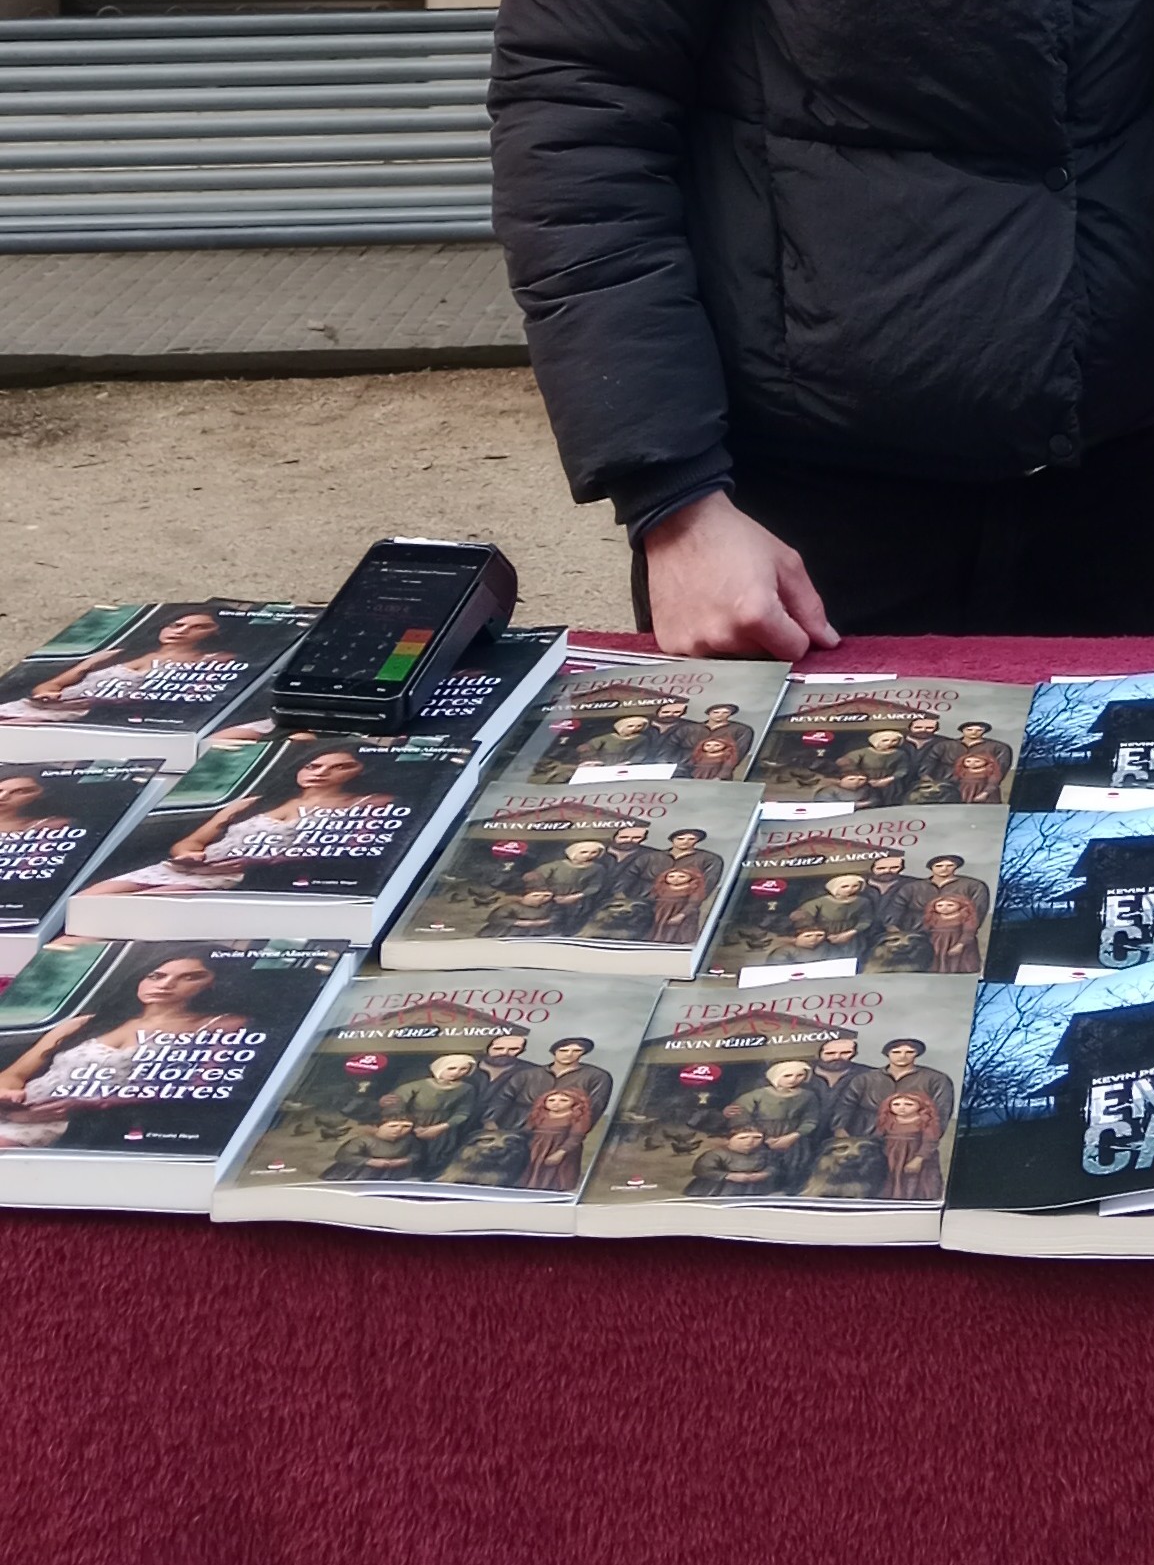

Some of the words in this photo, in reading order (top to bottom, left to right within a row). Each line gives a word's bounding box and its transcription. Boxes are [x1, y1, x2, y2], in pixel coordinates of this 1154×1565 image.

[150, 659, 249, 671] Vestido
[145, 668, 238, 681] blanco
[560, 672, 714, 693] TERRITORIO
[96, 677, 132, 689] de
[139, 678, 228, 692] flores
[80, 687, 217, 702] silvestres
[802, 688, 960, 704] TERRITORIO
[503, 791, 679, 808] TERRITORIO
[297, 804, 411, 818] Vestido
[295, 818, 403, 832] blanco
[243, 831, 282, 845] de
[292, 830, 394, 845] flores
[227, 843, 385, 858] silvestres
[363, 989, 564, 1010] TERRITORIO
[680, 991, 883, 1020] TERRITORIO
[136, 1028, 267, 1045] Vestido
[337, 1028, 386, 1040] KEVIN
[388, 1027, 439, 1039] PÉREZ
[439, 1024, 513, 1037] ALARCÓN
[664, 1039, 713, 1051] KEVIN
[715, 1035, 766, 1049] PÉREZ
[767, 1030, 841, 1045] ALARCÓN
[132, 1045, 256, 1062] blanco
[69, 1063, 116, 1081] de
[130, 1063, 246, 1082] flores
[1092, 1071, 1137, 1086] KEVIN
[51, 1081, 234, 1100] silvestres
